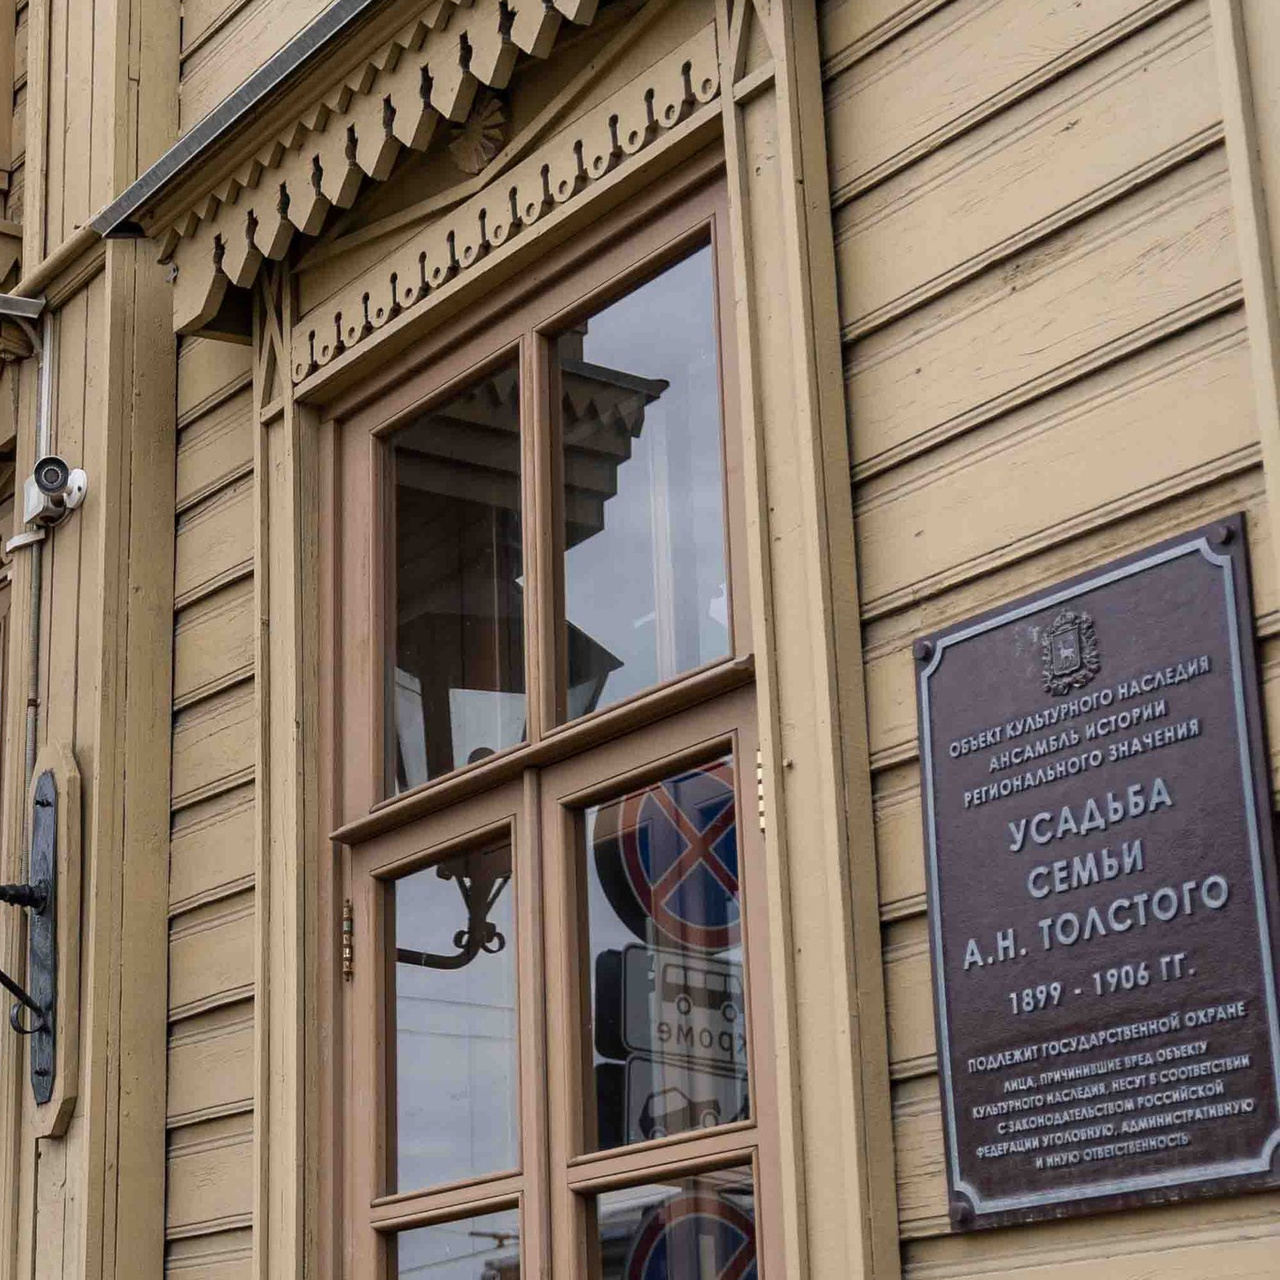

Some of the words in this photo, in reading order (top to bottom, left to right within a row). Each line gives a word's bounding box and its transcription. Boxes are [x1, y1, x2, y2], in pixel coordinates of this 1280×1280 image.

[949, 729, 1003, 758] ОБЪЕКТ
[1006, 688, 1113, 739] КУЛЬТУРНОГО
[1118, 655, 1210, 700] НАСЛЕДИЯ
[989, 730, 1080, 772] АНСАМБЛЬ
[1085, 700, 1167, 739] ИСТОРИИ
[963, 750, 1102, 808] РЕГИОНАЛЬНОГО
[1108, 718, 1200, 762] ЗНАЧЕНИЯ
[1008, 777, 1173, 852] УСАДЬБА
[1028, 838, 1144, 898] СЕМЬИ
[963, 928, 1027, 970] А.Н.
[1038, 875, 1229, 950] ТОЛСТОГО
[1009, 981, 1062, 1014] 1899
[1093, 962, 1150, 996] 1906
[968, 1045, 1039, 1072] ПОДЛЕЖИТ
[1042, 1012, 1180, 1057] ГОСУДАРСТВЕННОЙ
[1184, 1001, 1246, 1027] ОХРАНЕ
[1039, 1057, 1121, 1086] ПРИЧИНИВШИЕ
[1124, 1052, 1154, 1069] ВРЕД
[1156, 1040, 1208, 1062] ОБЪЕКТУ
[972, 1094, 1044, 1119] КУЛЬТУРНОГО
[1046, 1082, 1109, 1104] НАСЛЕДИЯ,
[1112, 1074, 1147, 1093] НЕСУТ
[1149, 1073, 1157, 1086] В
[1159, 1054, 1250, 1083] СООТВЕТСТВИИ
[997, 1122, 1006, 1135] С
[1008, 1099, 1135, 1132] ЗАКОНОДАТЕЛЬСТВОМ
[1137, 1078, 1225, 1109] РОССИЙСКОЙ
[976, 1136, 1039, 1159] ФЕДЕРАЦИИ
[1041, 1123, 1118, 1147] УГОЛОВНУЮ,
[1121, 1098, 1254, 1134] АДМИНИСТРАТИВНУЮ
[1035, 1157, 1043, 1169] И
[1046, 1151, 1080, 1167] ИНУЮ
[1083, 1133, 1189, 1161] ОТВЕТСТВЕННОСТЬ
